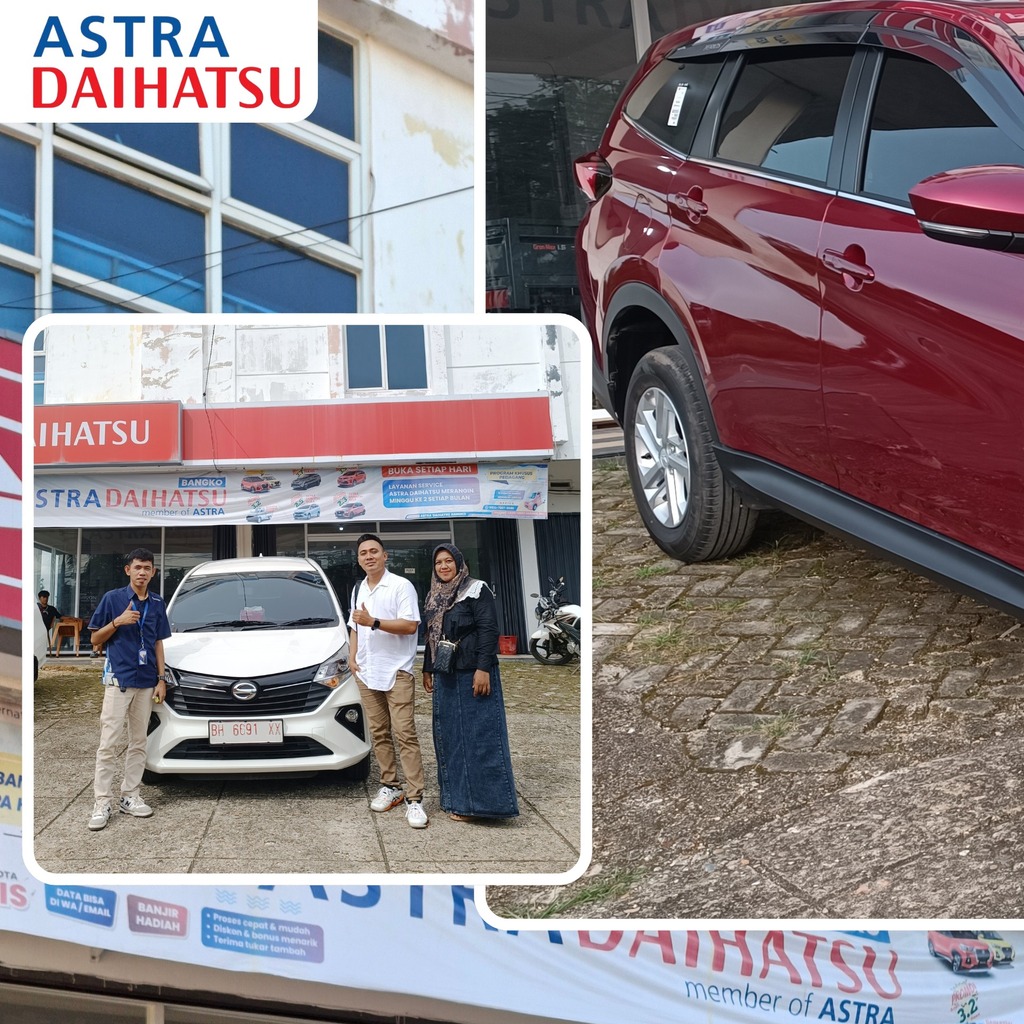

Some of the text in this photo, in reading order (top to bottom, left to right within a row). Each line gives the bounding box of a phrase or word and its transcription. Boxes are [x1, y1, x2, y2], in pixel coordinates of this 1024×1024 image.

[33, 419, 150, 447] IHATSU
[388, 465, 472, 475] BUKA SETIAP HARI
[181, 478, 223, 487] BANGKO
[105, 488, 228, 508] DAIHATSU
[141, 508, 225, 517] member of ASTRA
[211, 724, 225, 737] BH
[56, 888, 105, 906] DATA BISA
[50, 897, 59, 907] DI
[61, 900, 78, 912] WA
[83, 905, 111, 918] EMAIL
[137, 902, 179, 919] BANJIR
[135, 915, 181, 932] HADIAH
[213, 912, 311, 936] Proses cepat & mudah
[213, 924, 243, 937] Diskon
[251, 932, 280, 942] bonus
[280, 935, 318, 947] menarik
[213, 935, 306, 956] Terima tukar tambah
[684, 978, 782, 1014] member
[788, 993, 815, 1017] of
